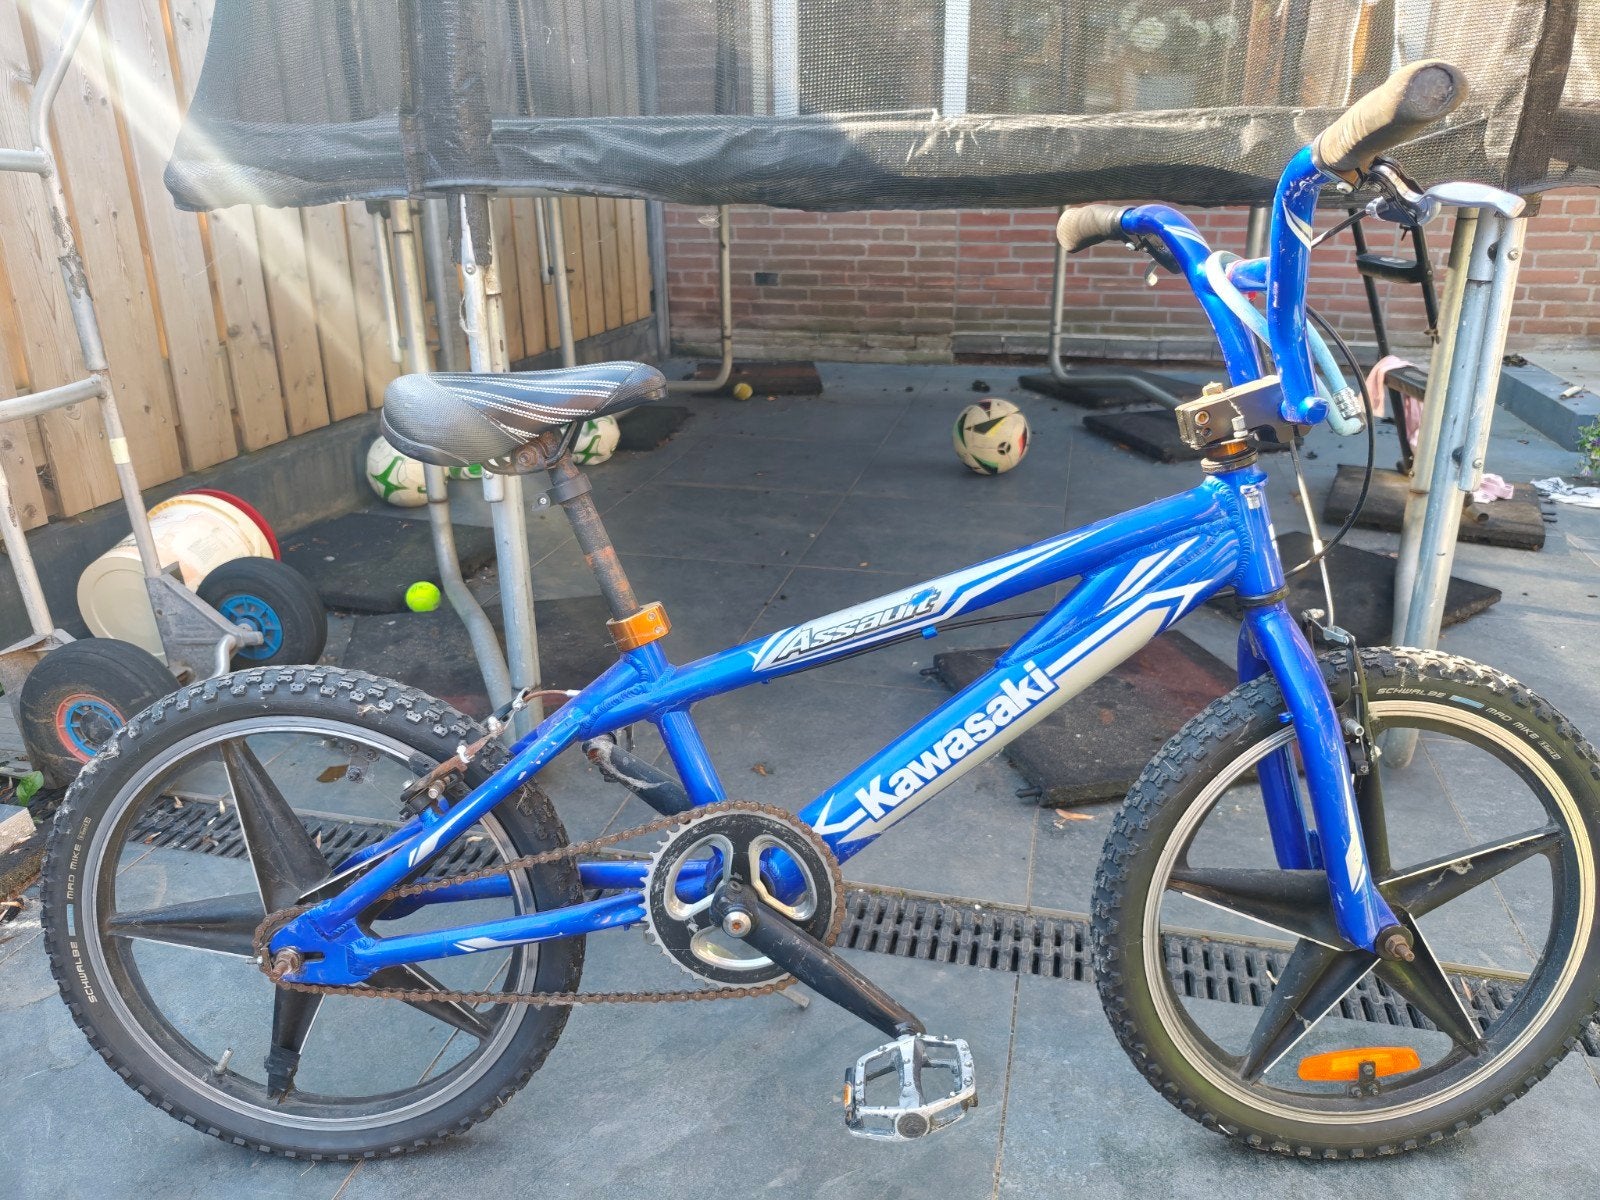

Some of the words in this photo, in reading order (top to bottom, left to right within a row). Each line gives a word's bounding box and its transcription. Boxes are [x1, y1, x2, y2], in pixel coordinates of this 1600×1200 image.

[1376, 687, 1447, 698] SCHWALBE
[1485, 707, 1512, 722] MAD
[1513, 721, 1540, 739] MIKE
[854, 660, 1057, 821] Kawasaki
[70, 844, 82, 870] MIKE
[67, 875, 75, 900] MAD
[70, 941, 97, 1004] SCHWALBE
